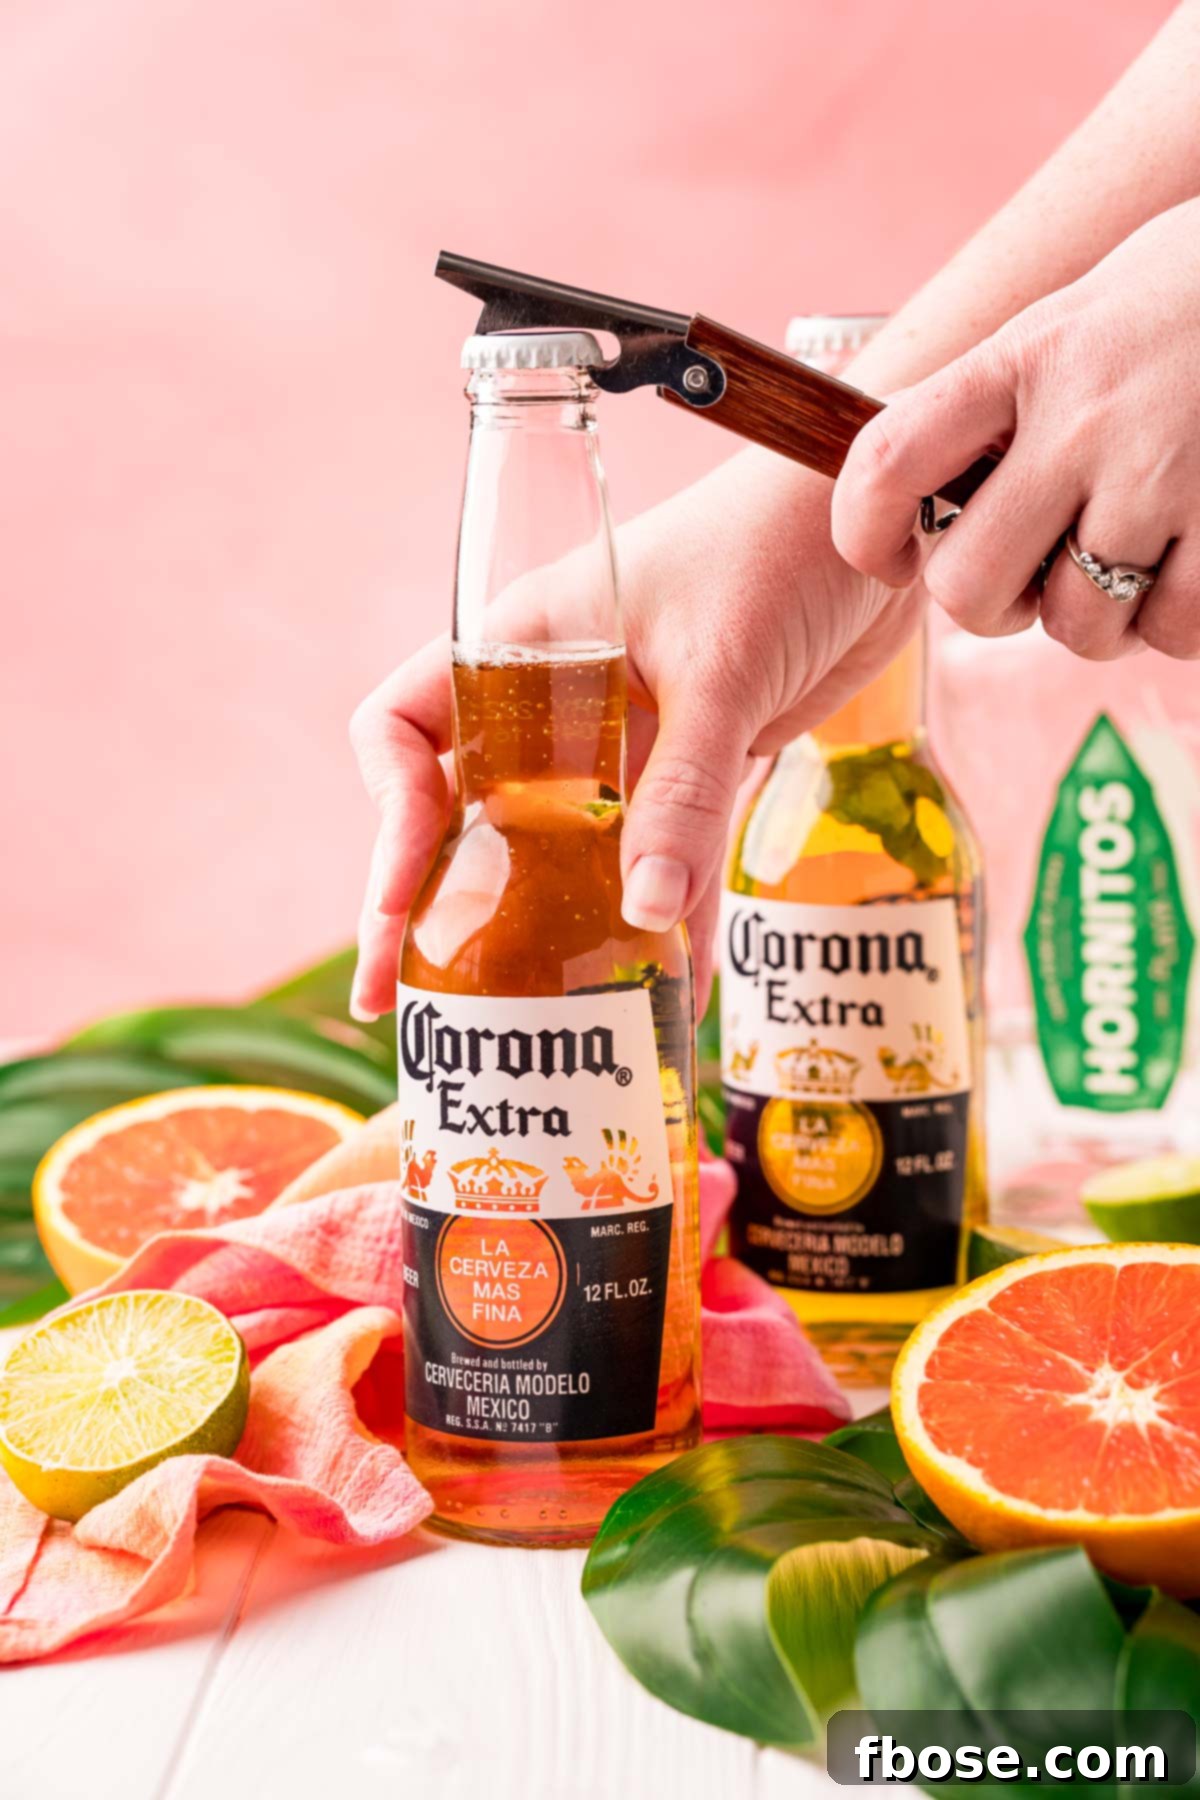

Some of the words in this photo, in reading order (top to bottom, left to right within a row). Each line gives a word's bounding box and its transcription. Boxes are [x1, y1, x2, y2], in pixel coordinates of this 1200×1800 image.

[729, 909, 926, 987] Corona
[1078, 781, 1140, 1095] HORNITOS
[766, 979, 885, 1028] Extra
[401, 1000, 618, 1093] Corona
[437, 1079, 572, 1137] Extra
[799, 1116, 829, 1135] LA
[590, 1224, 625, 1239] MARC.
[626, 1220, 650, 1235] REG.
[480, 1238, 511, 1257] LA
[449, 1256, 549, 1279] CERVEZA
[472, 1282, 521, 1301] MAS
[583, 1284, 602, 1303] 12
[472, 1302, 523, 1323] FINA
[451, 1351, 481, 1368] Brewed
[482, 1358, 499, 1369] and
[500, 1358, 534, 1371] bottled
[536, 1358, 548, 1373] by
[425, 1361, 511, 1395] CERVECERIA
[515, 1372, 591, 1396] MODELO
[466, 1394, 530, 1420] MEXICO
[445, 1414, 464, 1428] REG.
[511, 1422, 537, 1433] 7417
